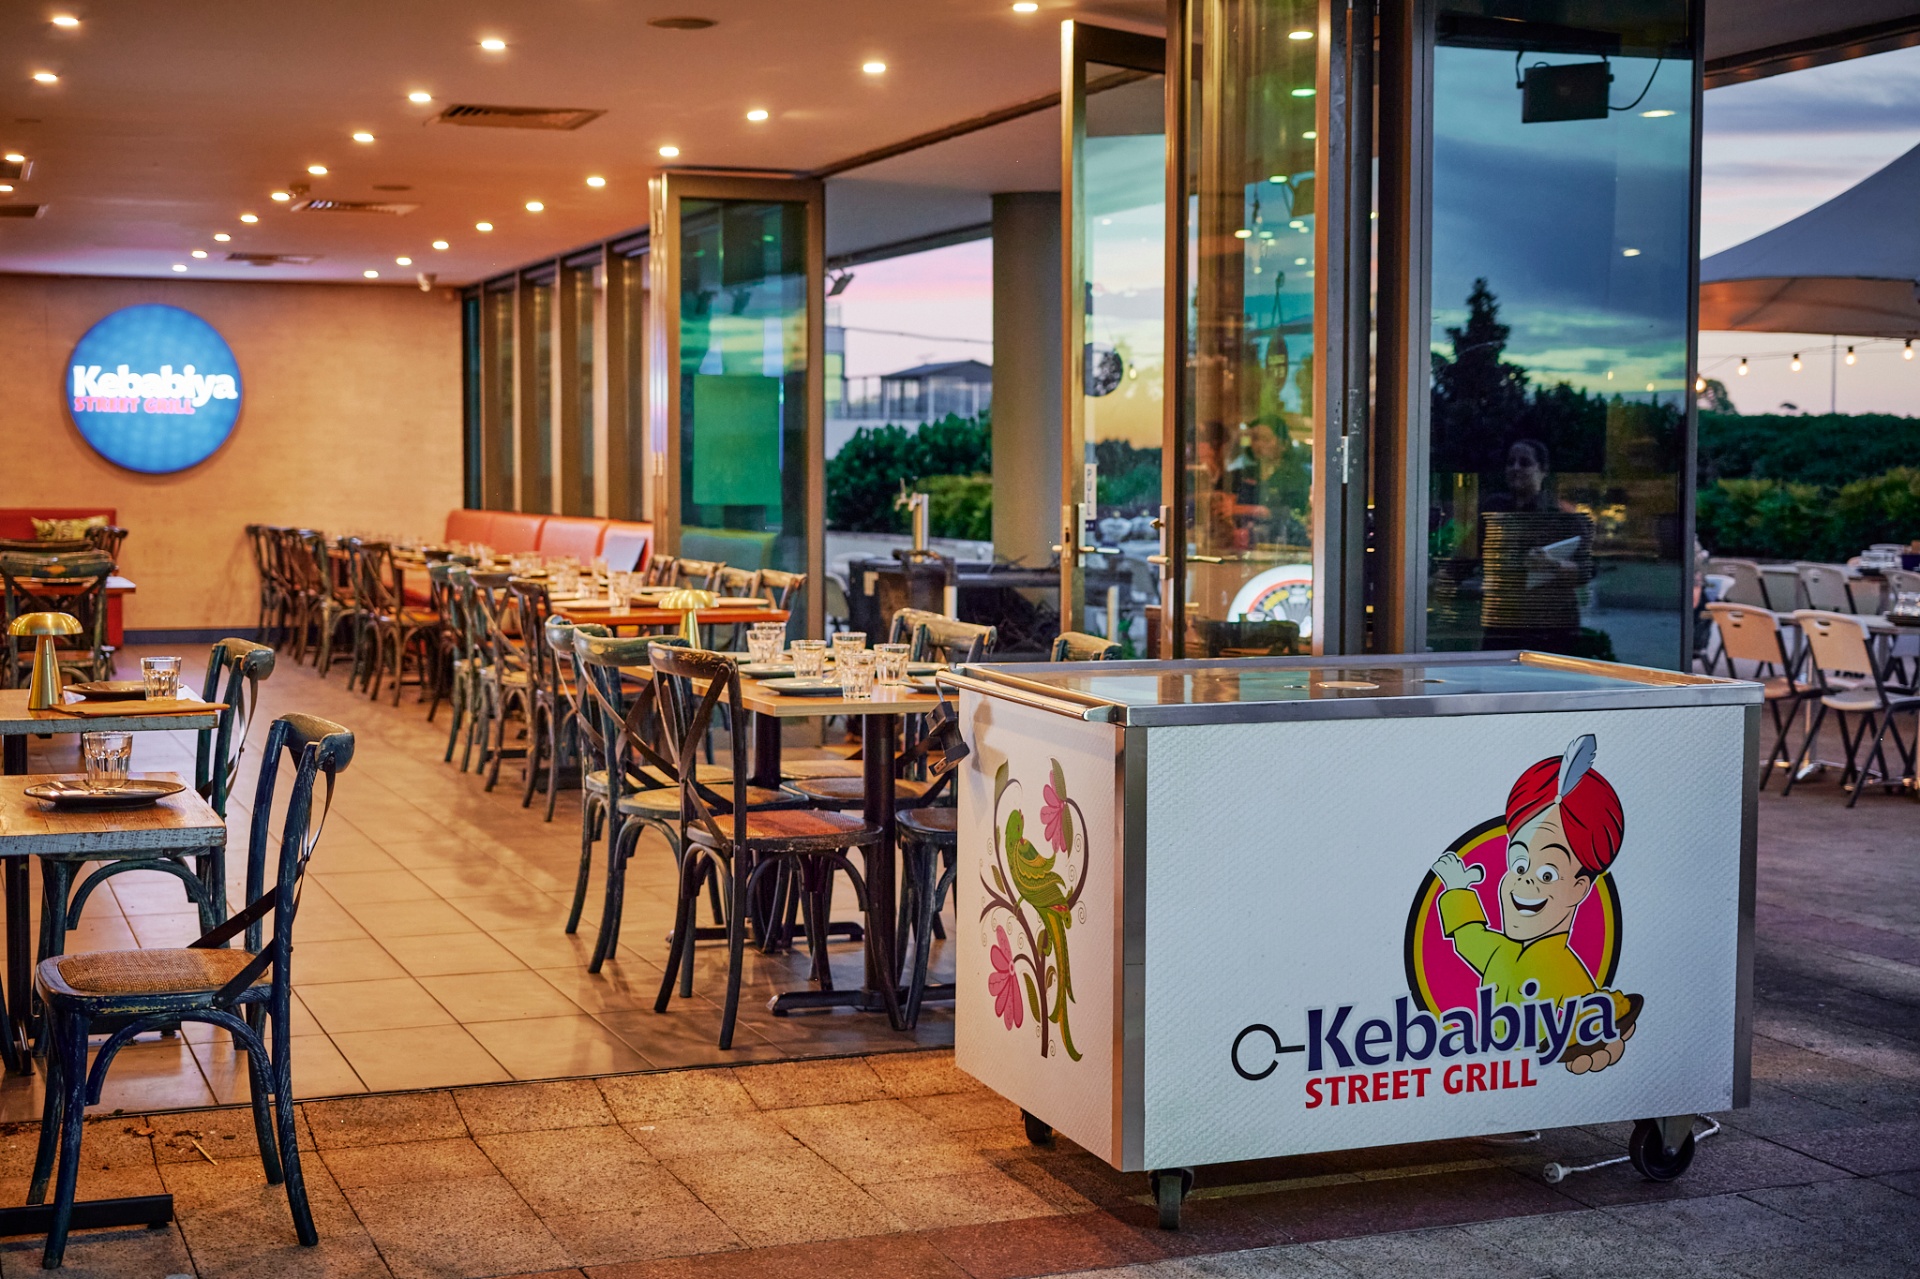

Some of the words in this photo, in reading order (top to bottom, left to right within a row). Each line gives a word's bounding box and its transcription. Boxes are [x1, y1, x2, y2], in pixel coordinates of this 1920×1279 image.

[73, 364, 238, 407] Kebabiya
[74, 396, 140, 413] STREET
[143, 397, 195, 415] GRILL
[1307, 981, 1618, 1071] Kebabiya
[1304, 1067, 1431, 1108] STREET
[1442, 1059, 1538, 1095] GRILL
